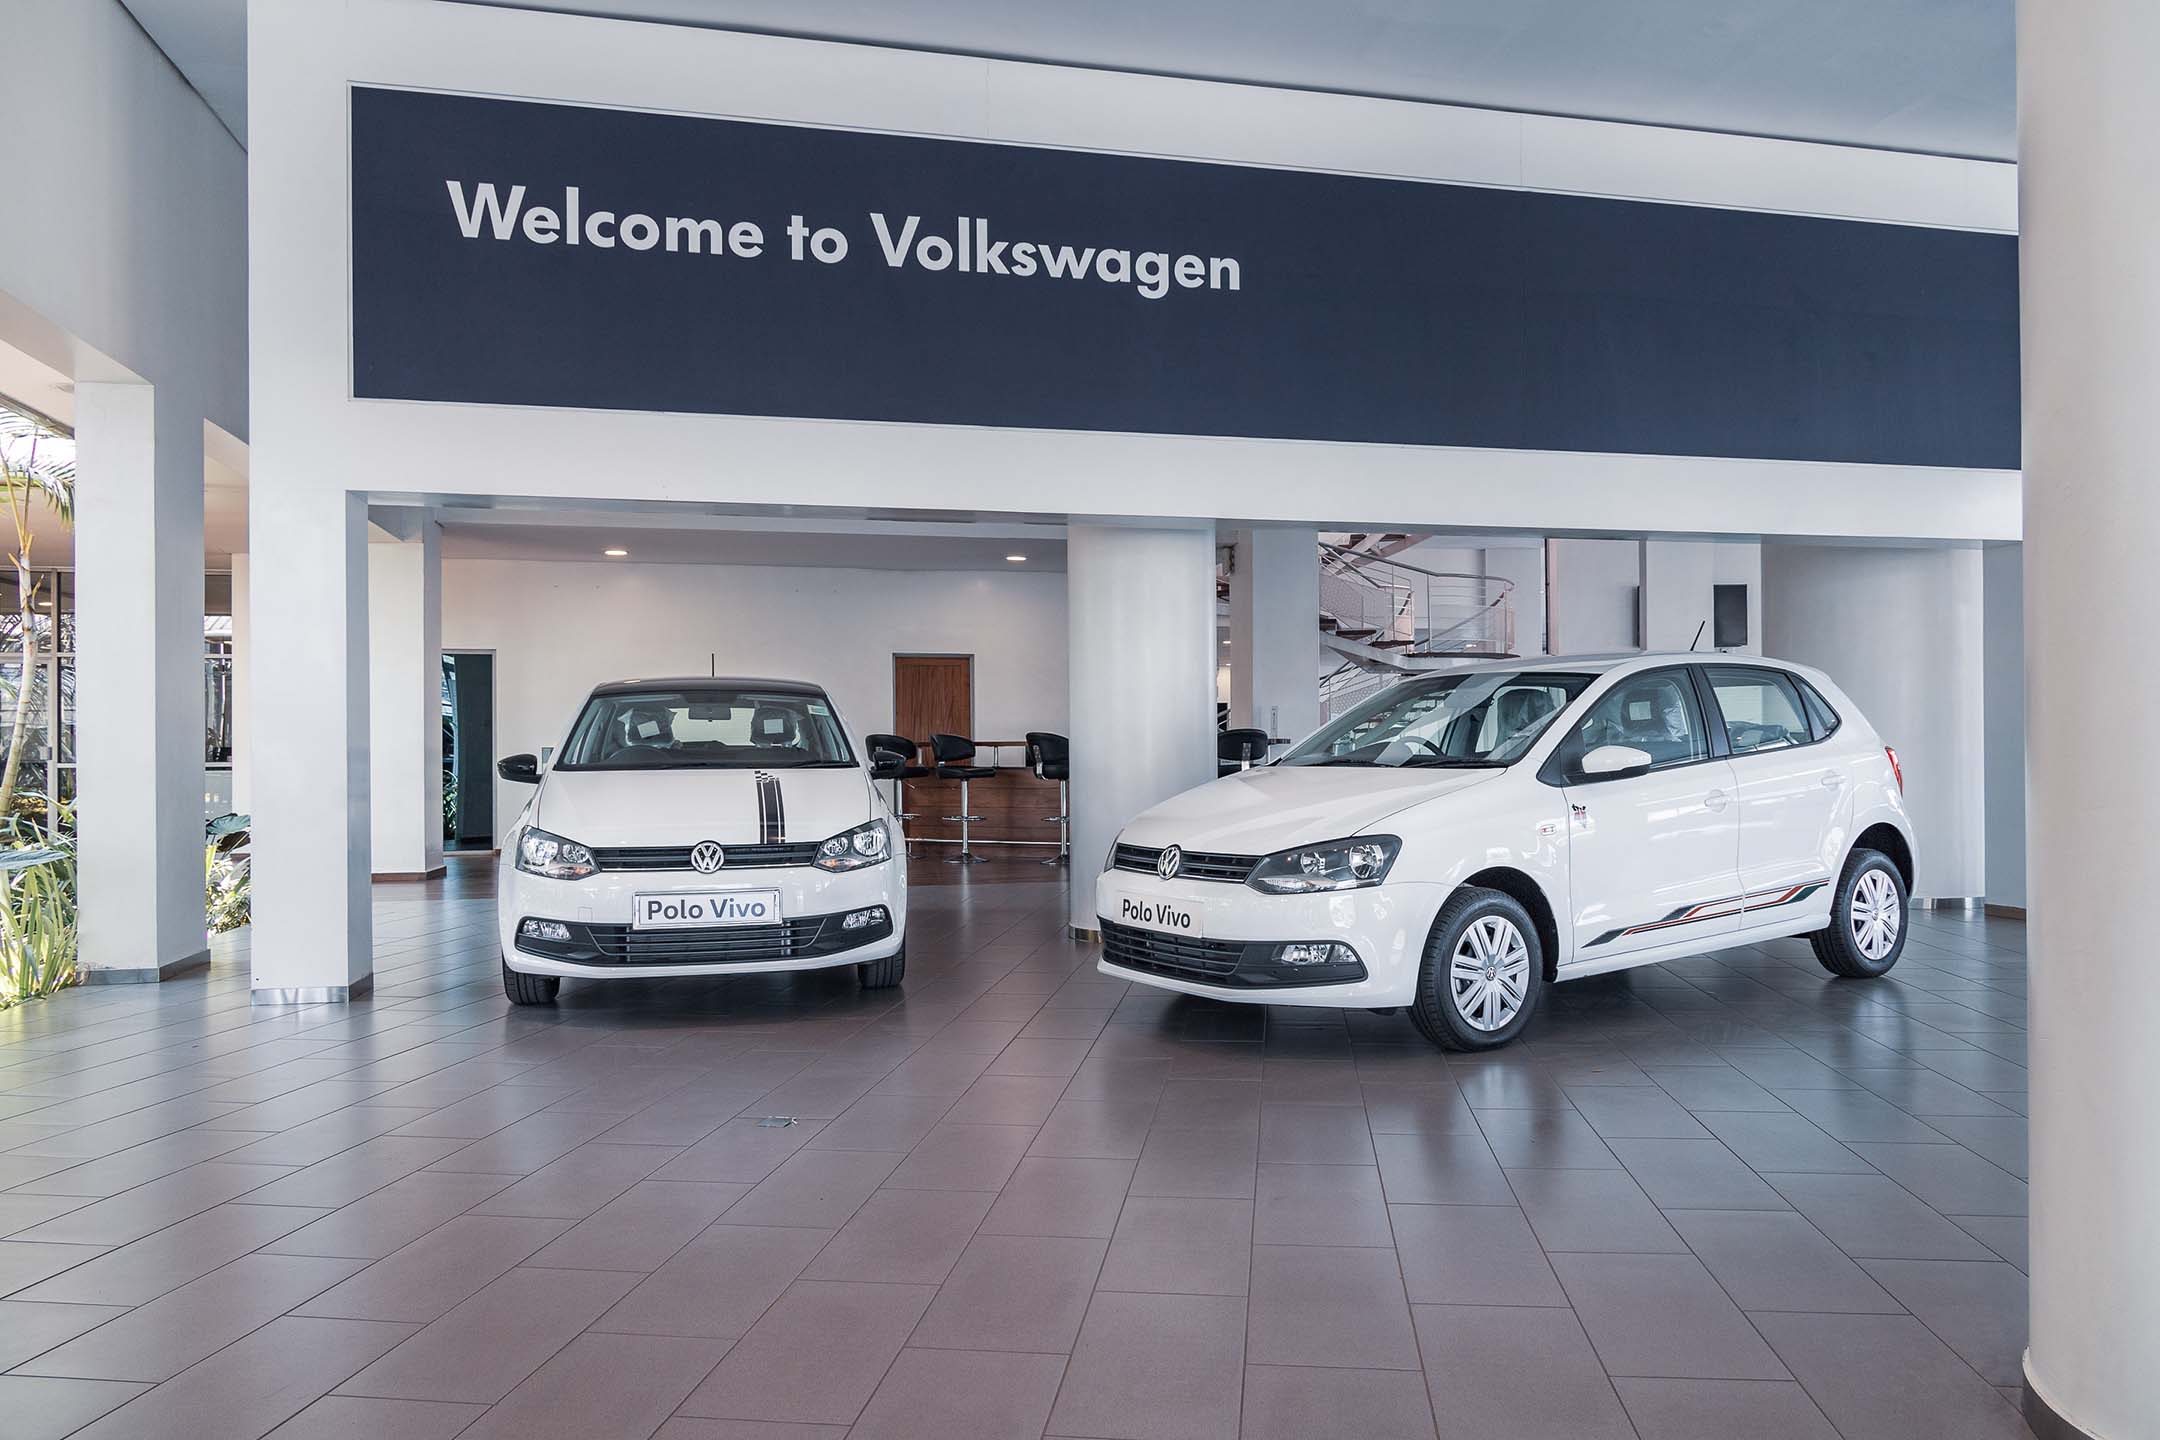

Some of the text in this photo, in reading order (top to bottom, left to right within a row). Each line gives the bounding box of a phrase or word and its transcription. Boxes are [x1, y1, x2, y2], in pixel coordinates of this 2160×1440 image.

[446, 181, 1240, 299] Welcome to Volkswagen
[647, 898, 766, 920] Polo Vivo
[1122, 899, 1190, 928] Polo Vivo
